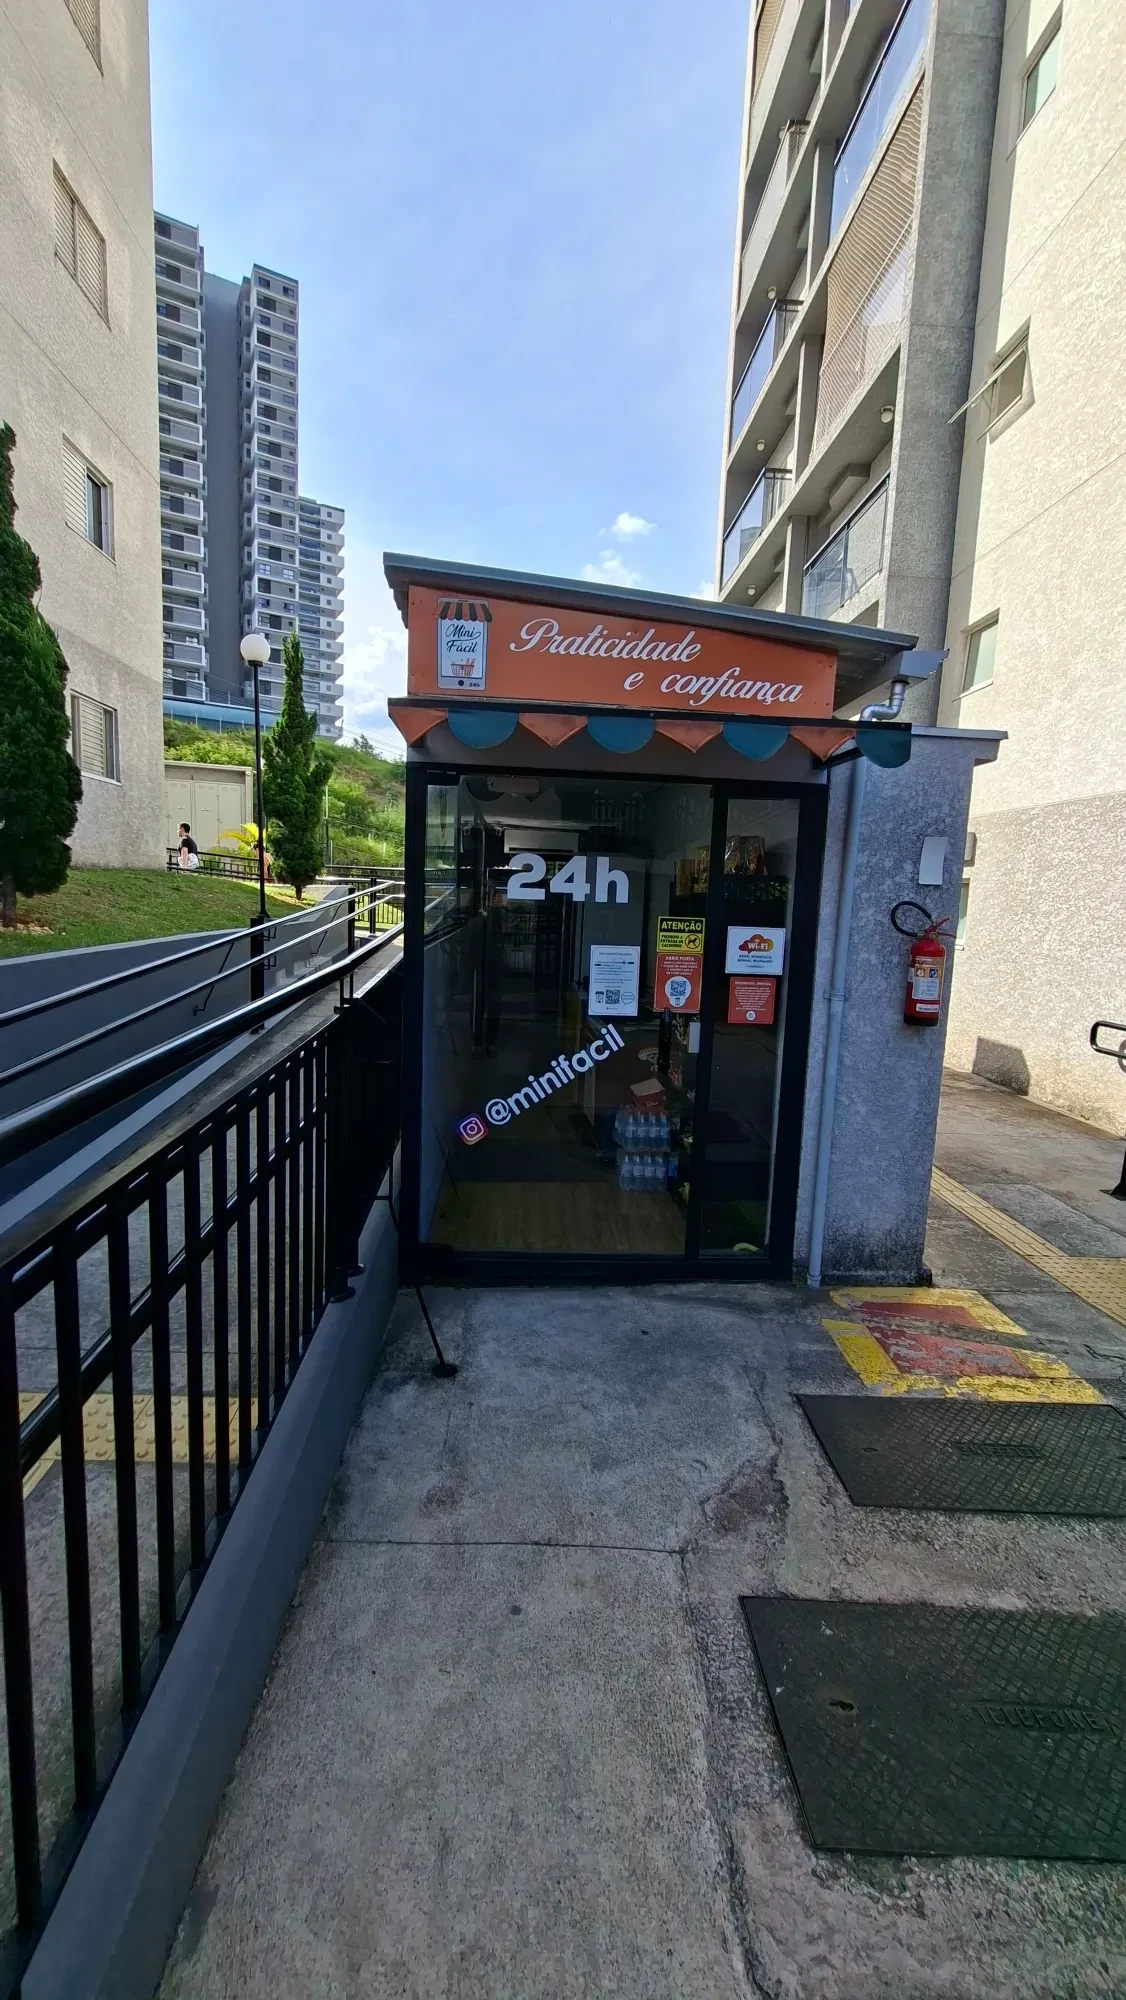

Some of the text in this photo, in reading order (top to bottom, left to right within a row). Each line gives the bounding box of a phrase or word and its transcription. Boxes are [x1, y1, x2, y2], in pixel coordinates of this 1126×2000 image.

[445, 623, 482, 640] Mini
[509, 618, 702, 662] Praticidade
[445, 641, 478, 653] Fácil
[623, 666, 804, 706] e confiança
[507, 852, 629, 904] 24h
[661, 920, 702, 932] ATENÇÃO
[747, 942, 768, 950] Wi-Fi
[485, 1023, 626, 1125] @minifacil
[969, 1704, 1104, 1730] TELEFONE
